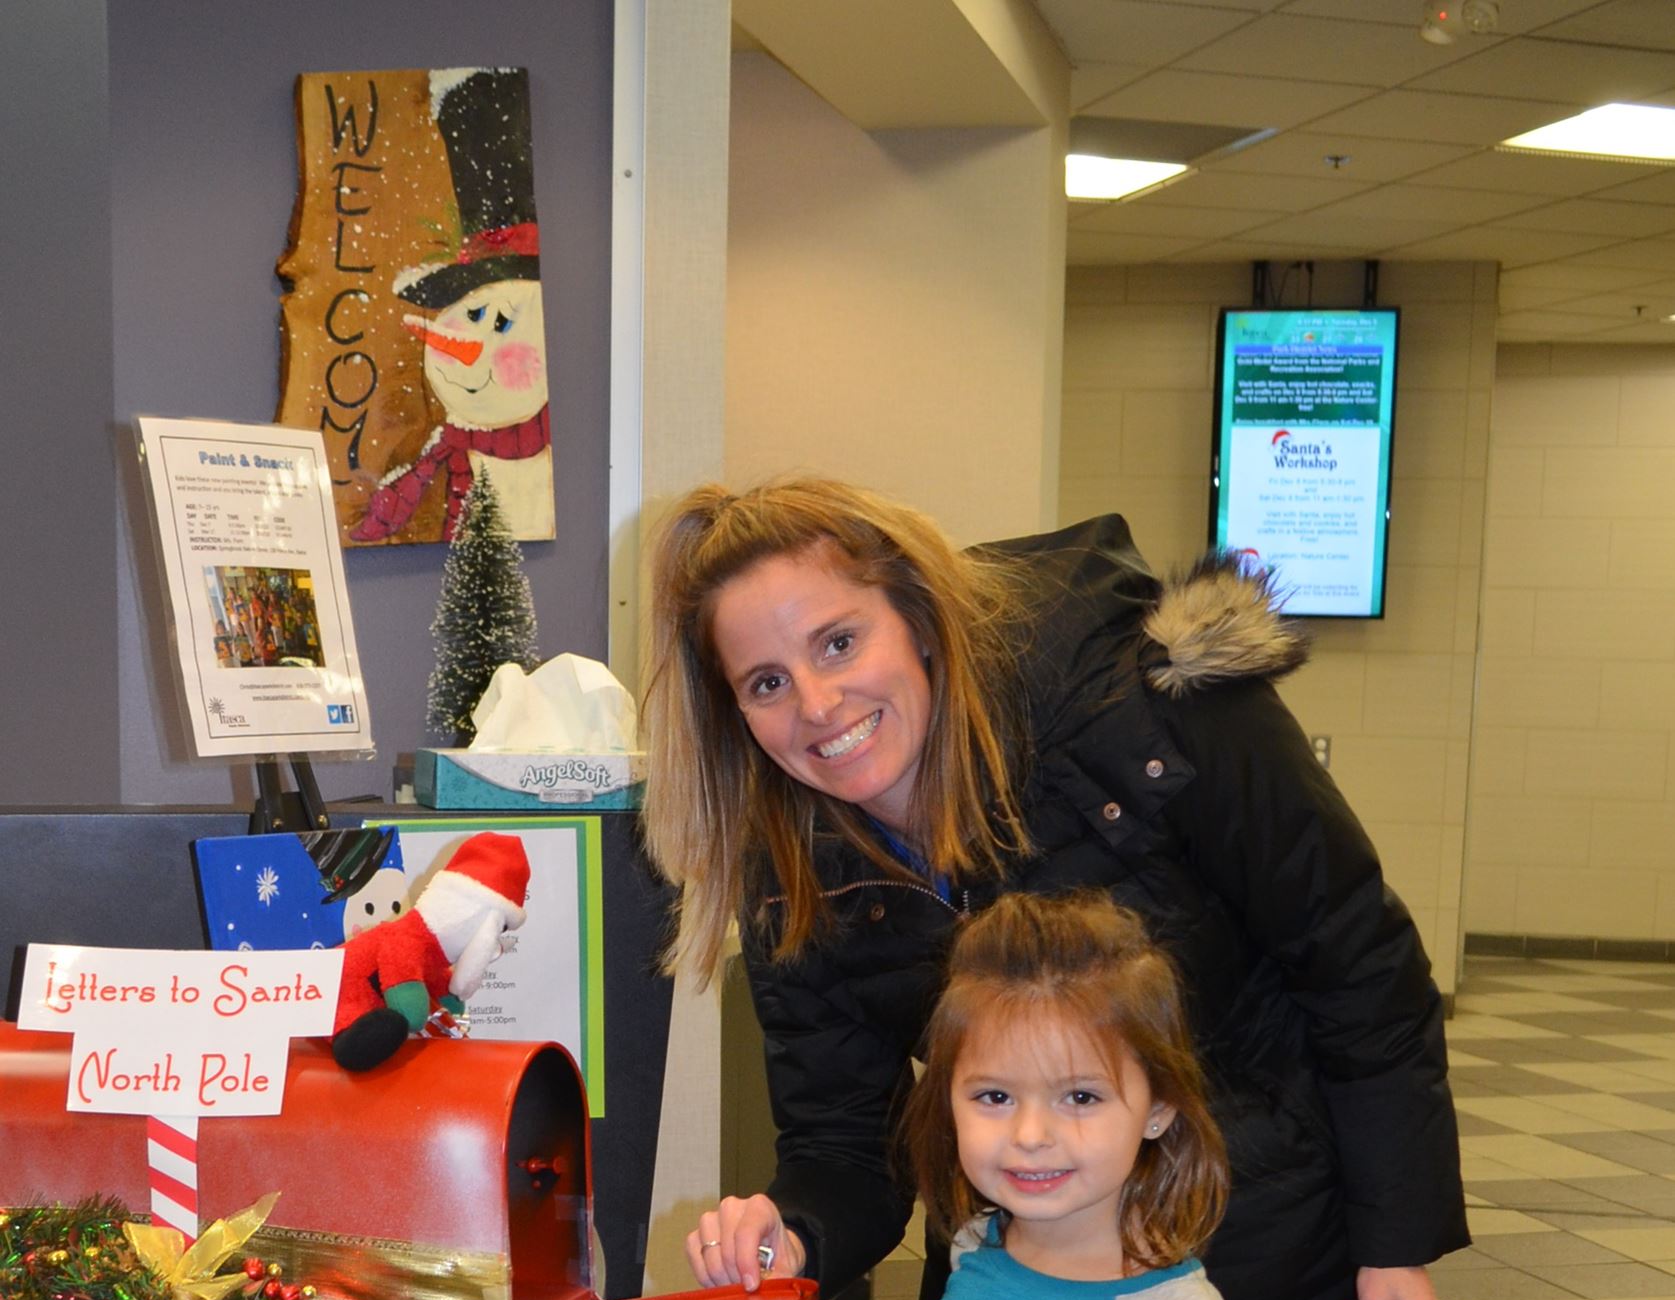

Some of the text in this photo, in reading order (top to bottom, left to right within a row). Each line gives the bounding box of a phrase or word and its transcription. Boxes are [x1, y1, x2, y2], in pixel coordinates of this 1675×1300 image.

[321, 79, 382, 486] WELCOM
[1280, 440, 1332, 454] Santa's
[199, 451, 236, 467] Paint
[240, 454, 250, 467] &
[1274, 455, 1337, 471] Workshop
[46, 961, 322, 1017] Letters to Santa
[469, 1006, 502, 1015] Saturday
[78, 1048, 269, 1106] North Pole
